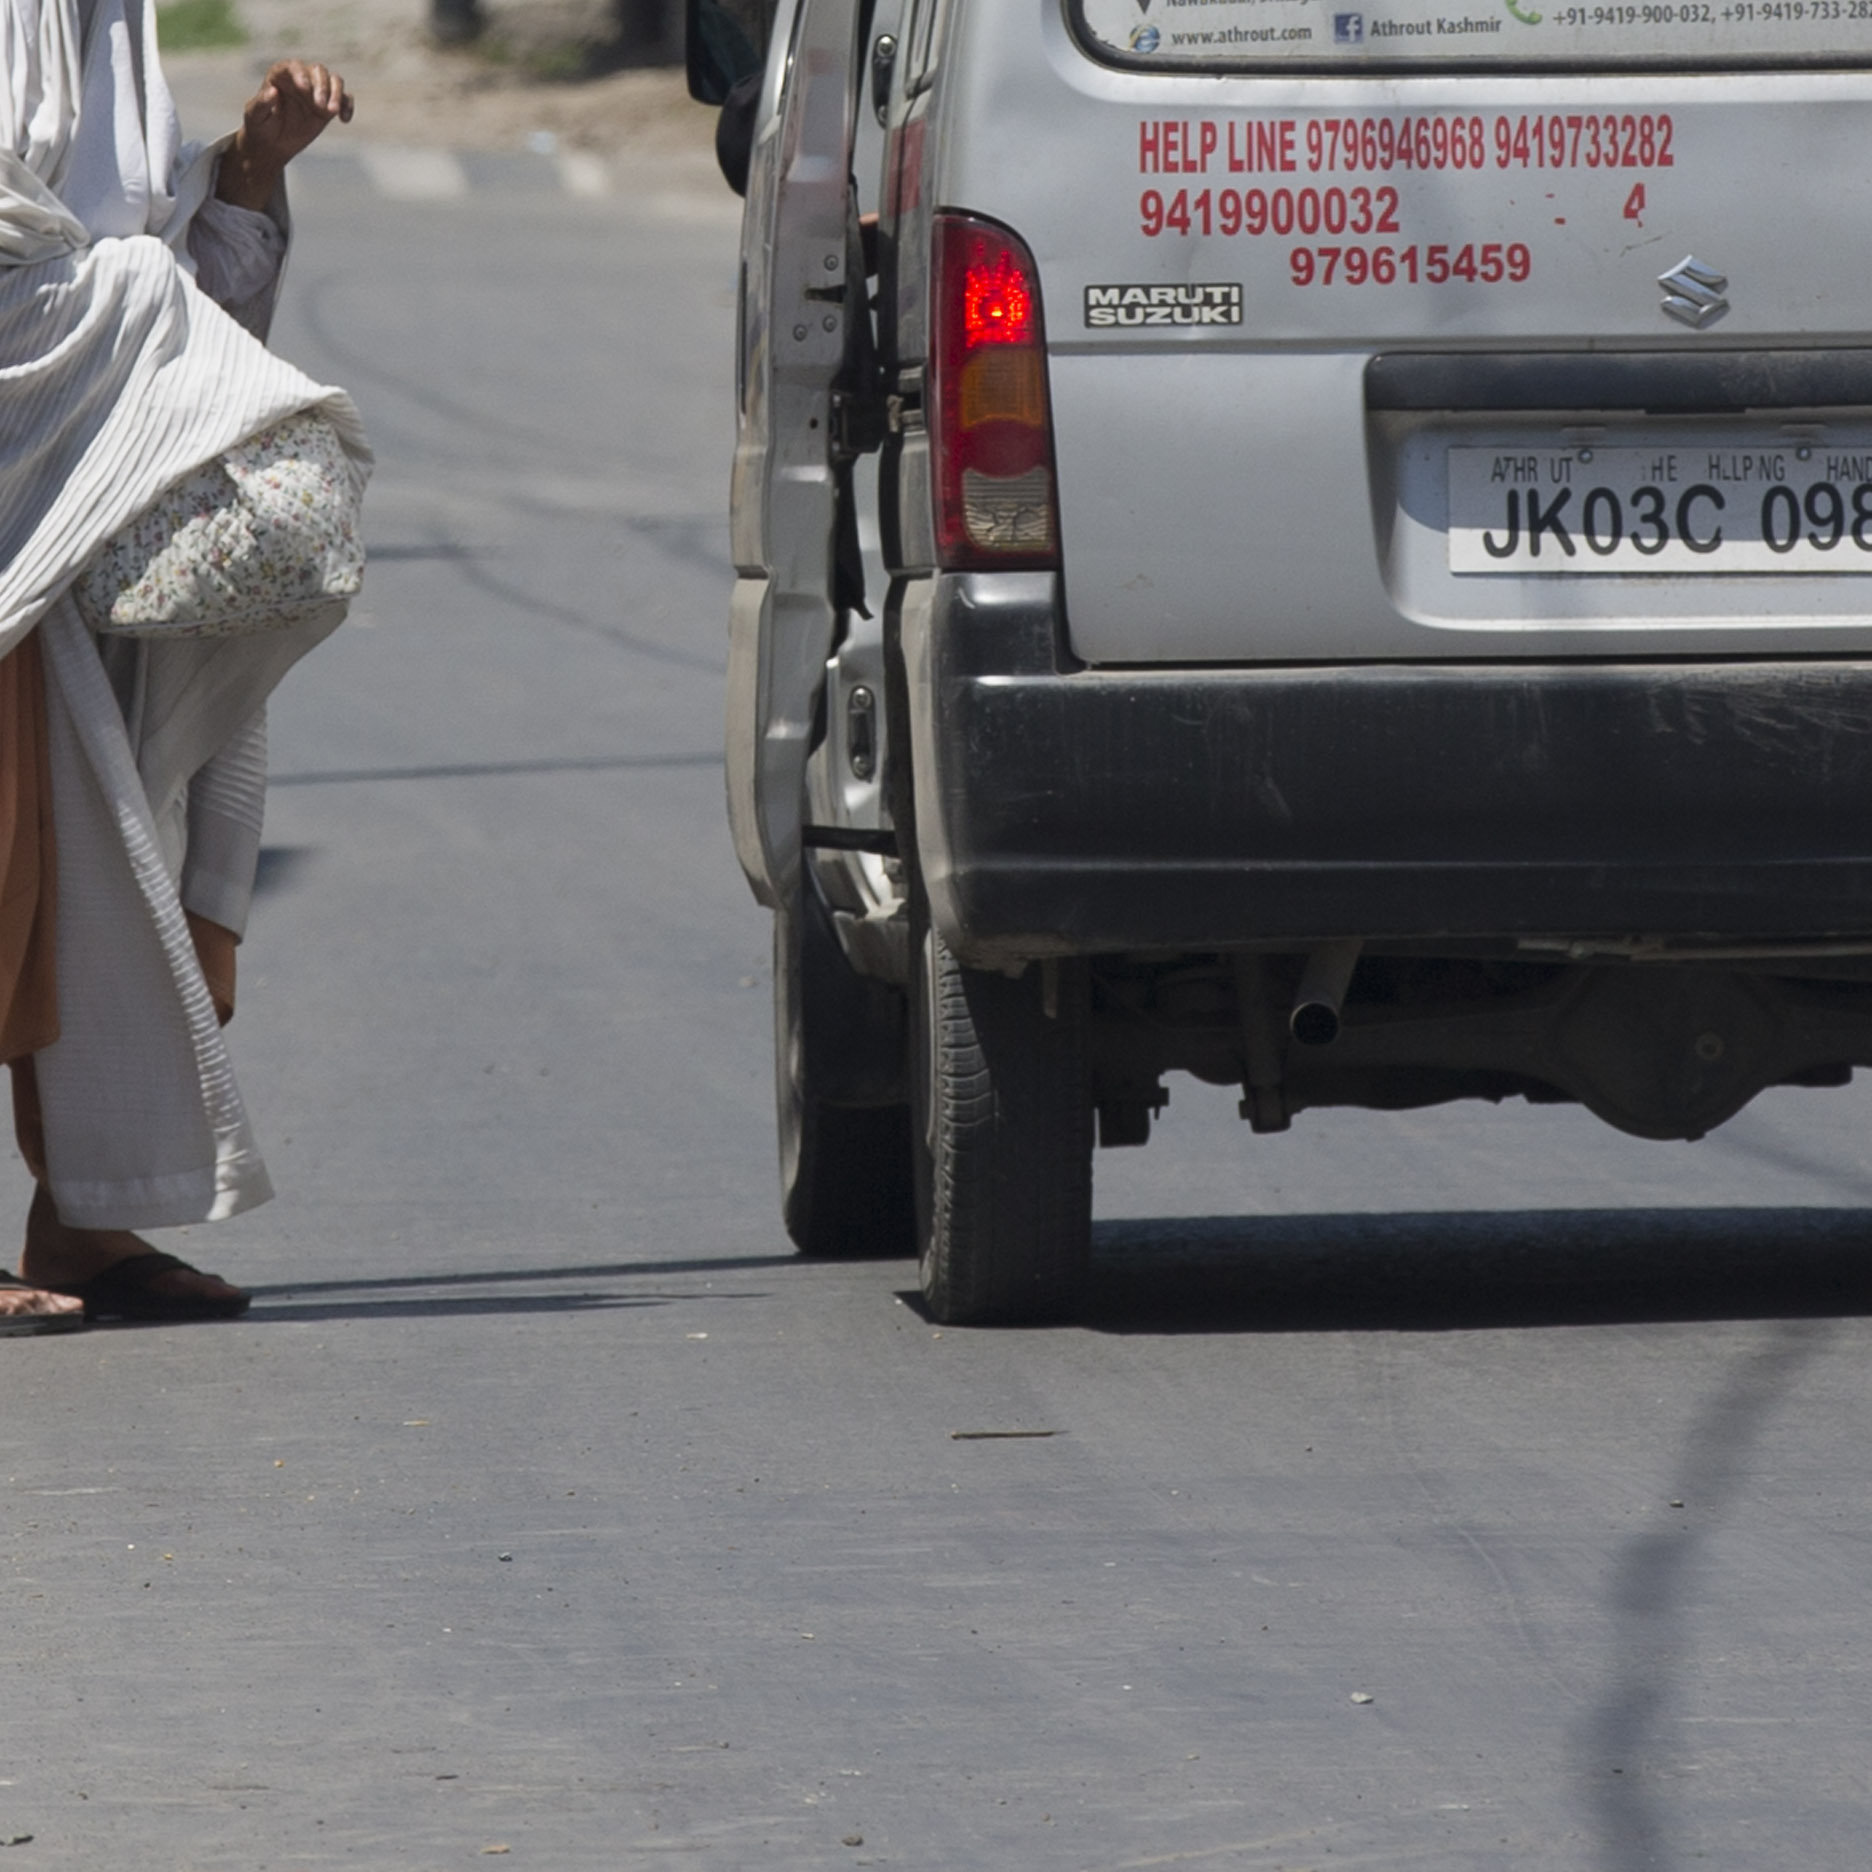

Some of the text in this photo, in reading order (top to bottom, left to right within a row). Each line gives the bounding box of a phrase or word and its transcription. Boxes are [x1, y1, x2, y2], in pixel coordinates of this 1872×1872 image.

[1371, 17, 1501, 37] Athrout Kashmir
[1552, 1, 1716, 27] +91-9419-900-032,
[1171, 24, 1312, 47] www.athrout.com
[1140, 114, 1674, 173] HELP LINE 9796946968 9419733282
[1140, 185, 1400, 236] 9419900032
[1290, 243, 1530, 286] 979615459
[1088, 287, 1240, 306] MARUTI
[1088, 306, 1240, 325] SUZUKI
[1483, 484, 1726, 557] JK03C
